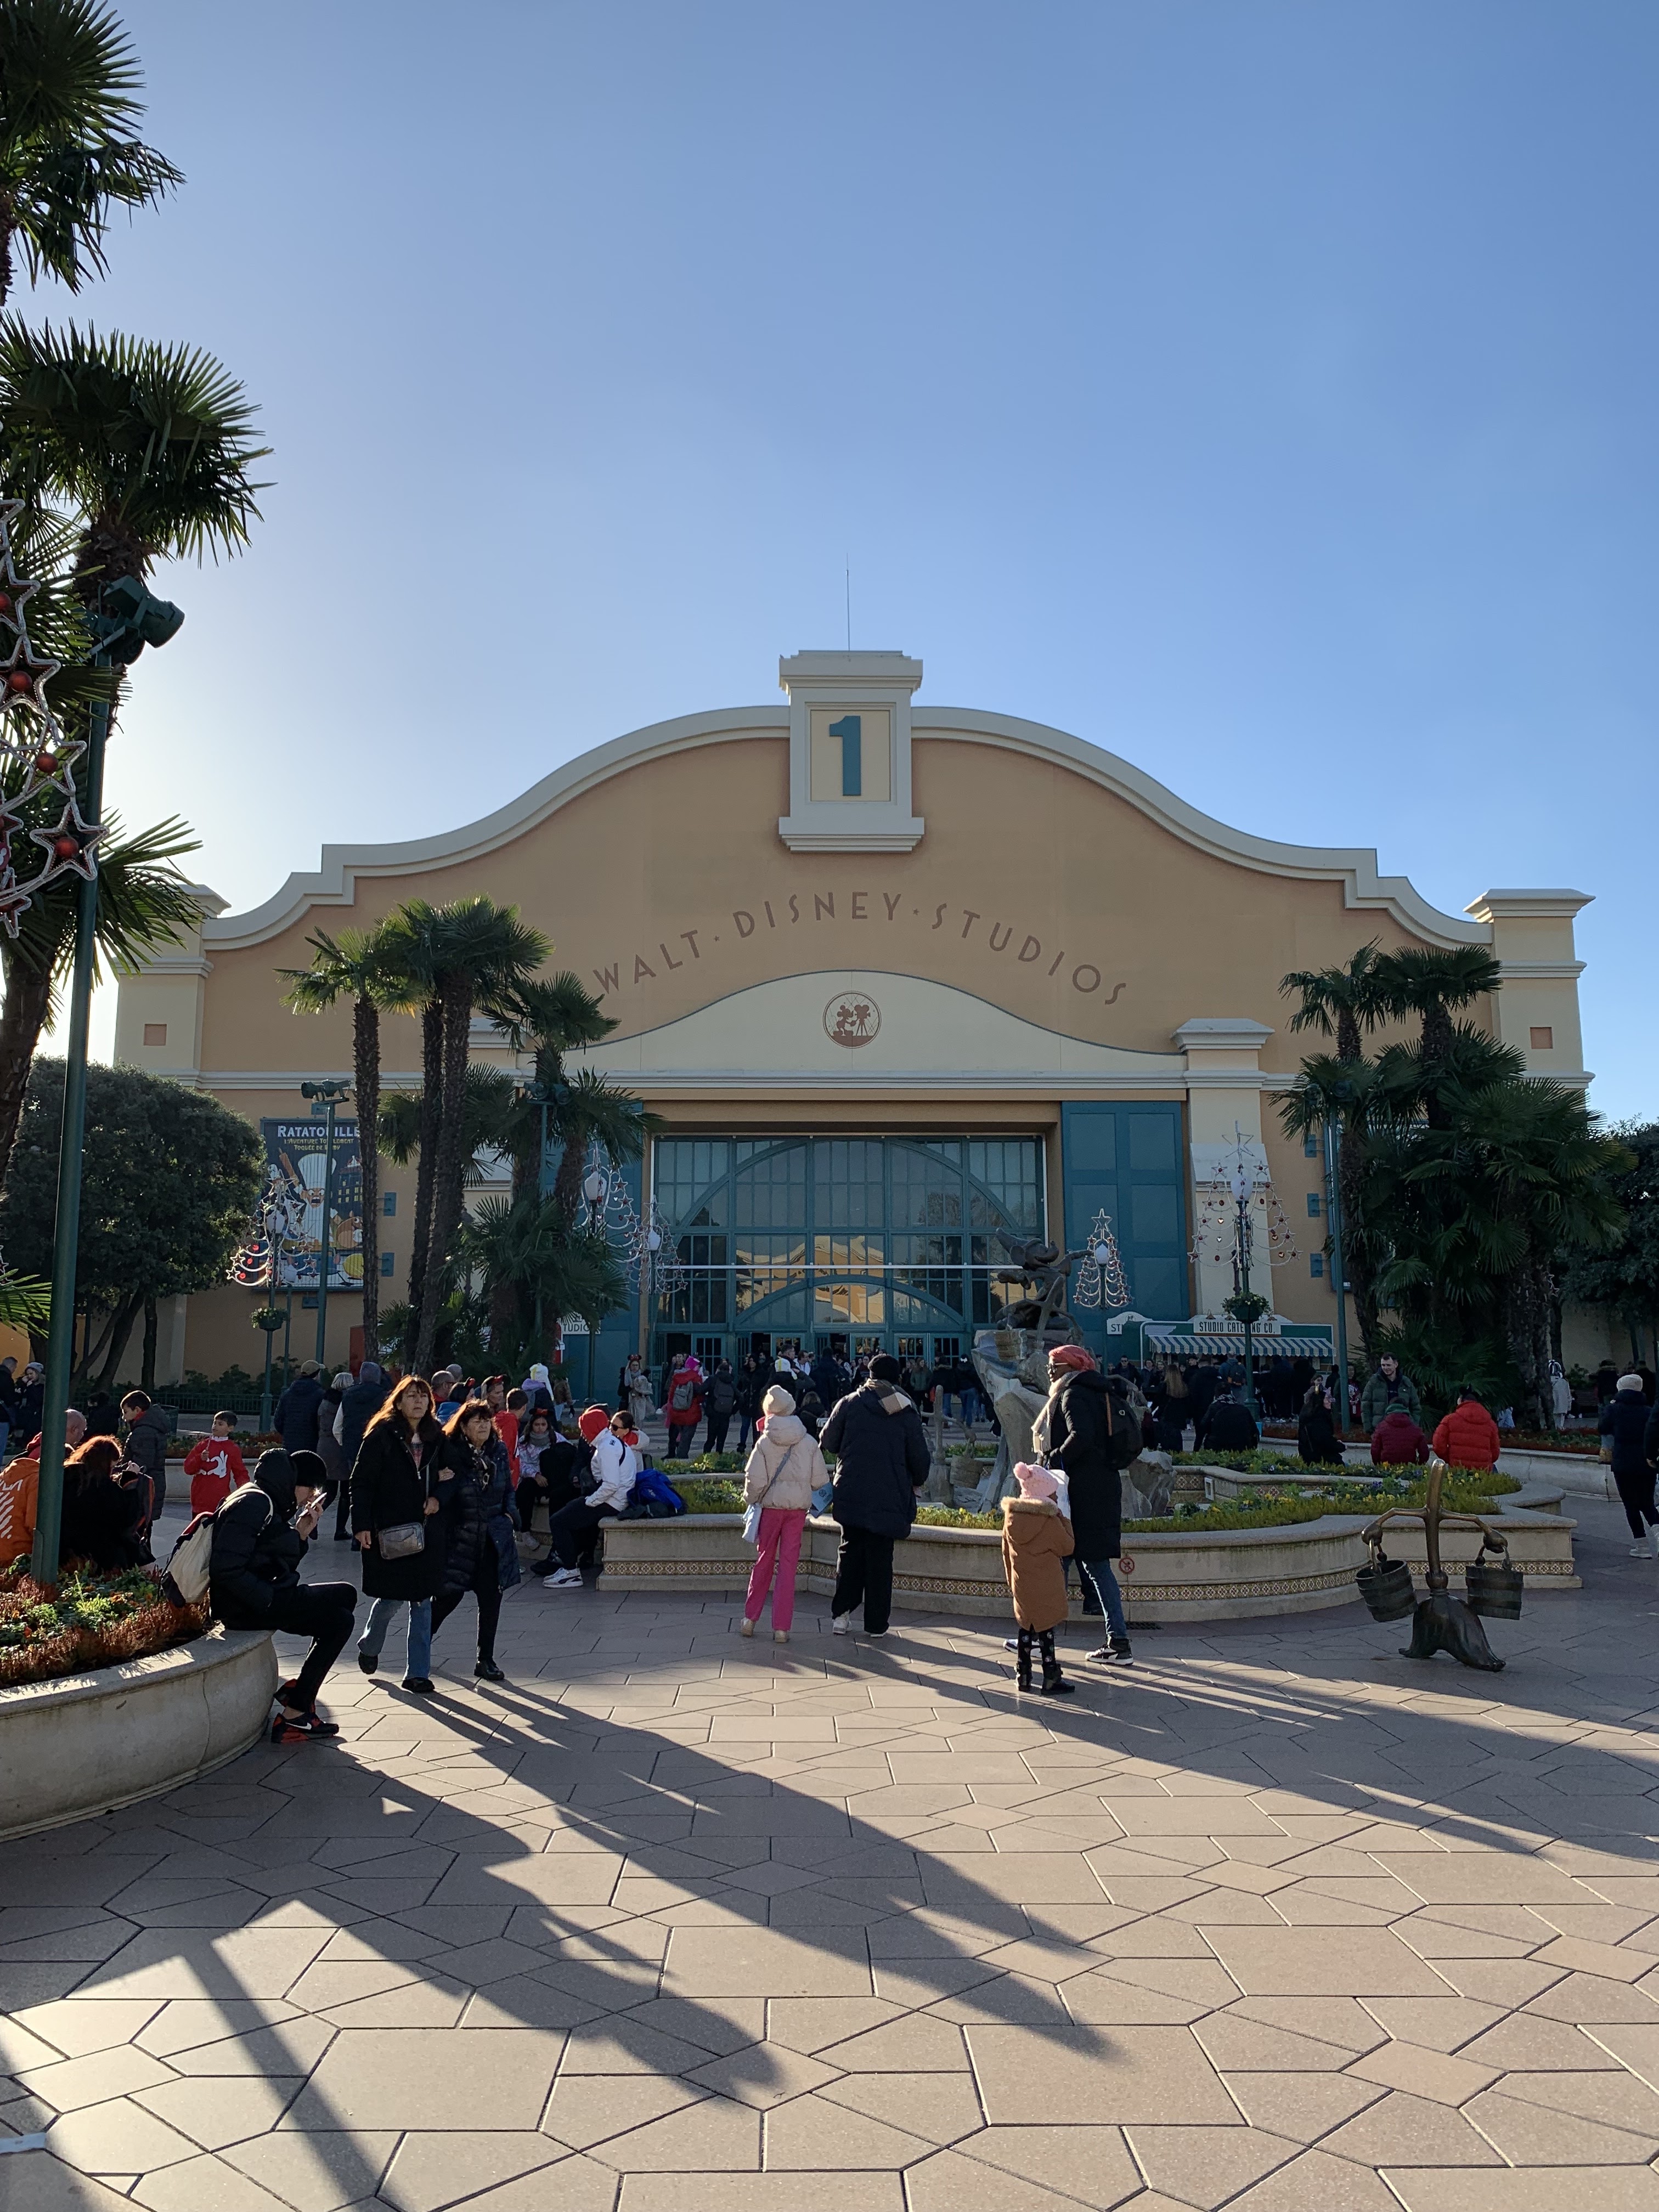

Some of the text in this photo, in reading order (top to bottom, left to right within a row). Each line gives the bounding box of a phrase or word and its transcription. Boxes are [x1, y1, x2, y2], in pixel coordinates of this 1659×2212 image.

[829, 715, 862, 797] 1
[592, 891, 1126, 1005] WALT DISNEY STUDIOS
[562, 1323, 590, 1331] TUDIO
[1199, 1322, 1276, 1334] STUDIO CATENG CO.
